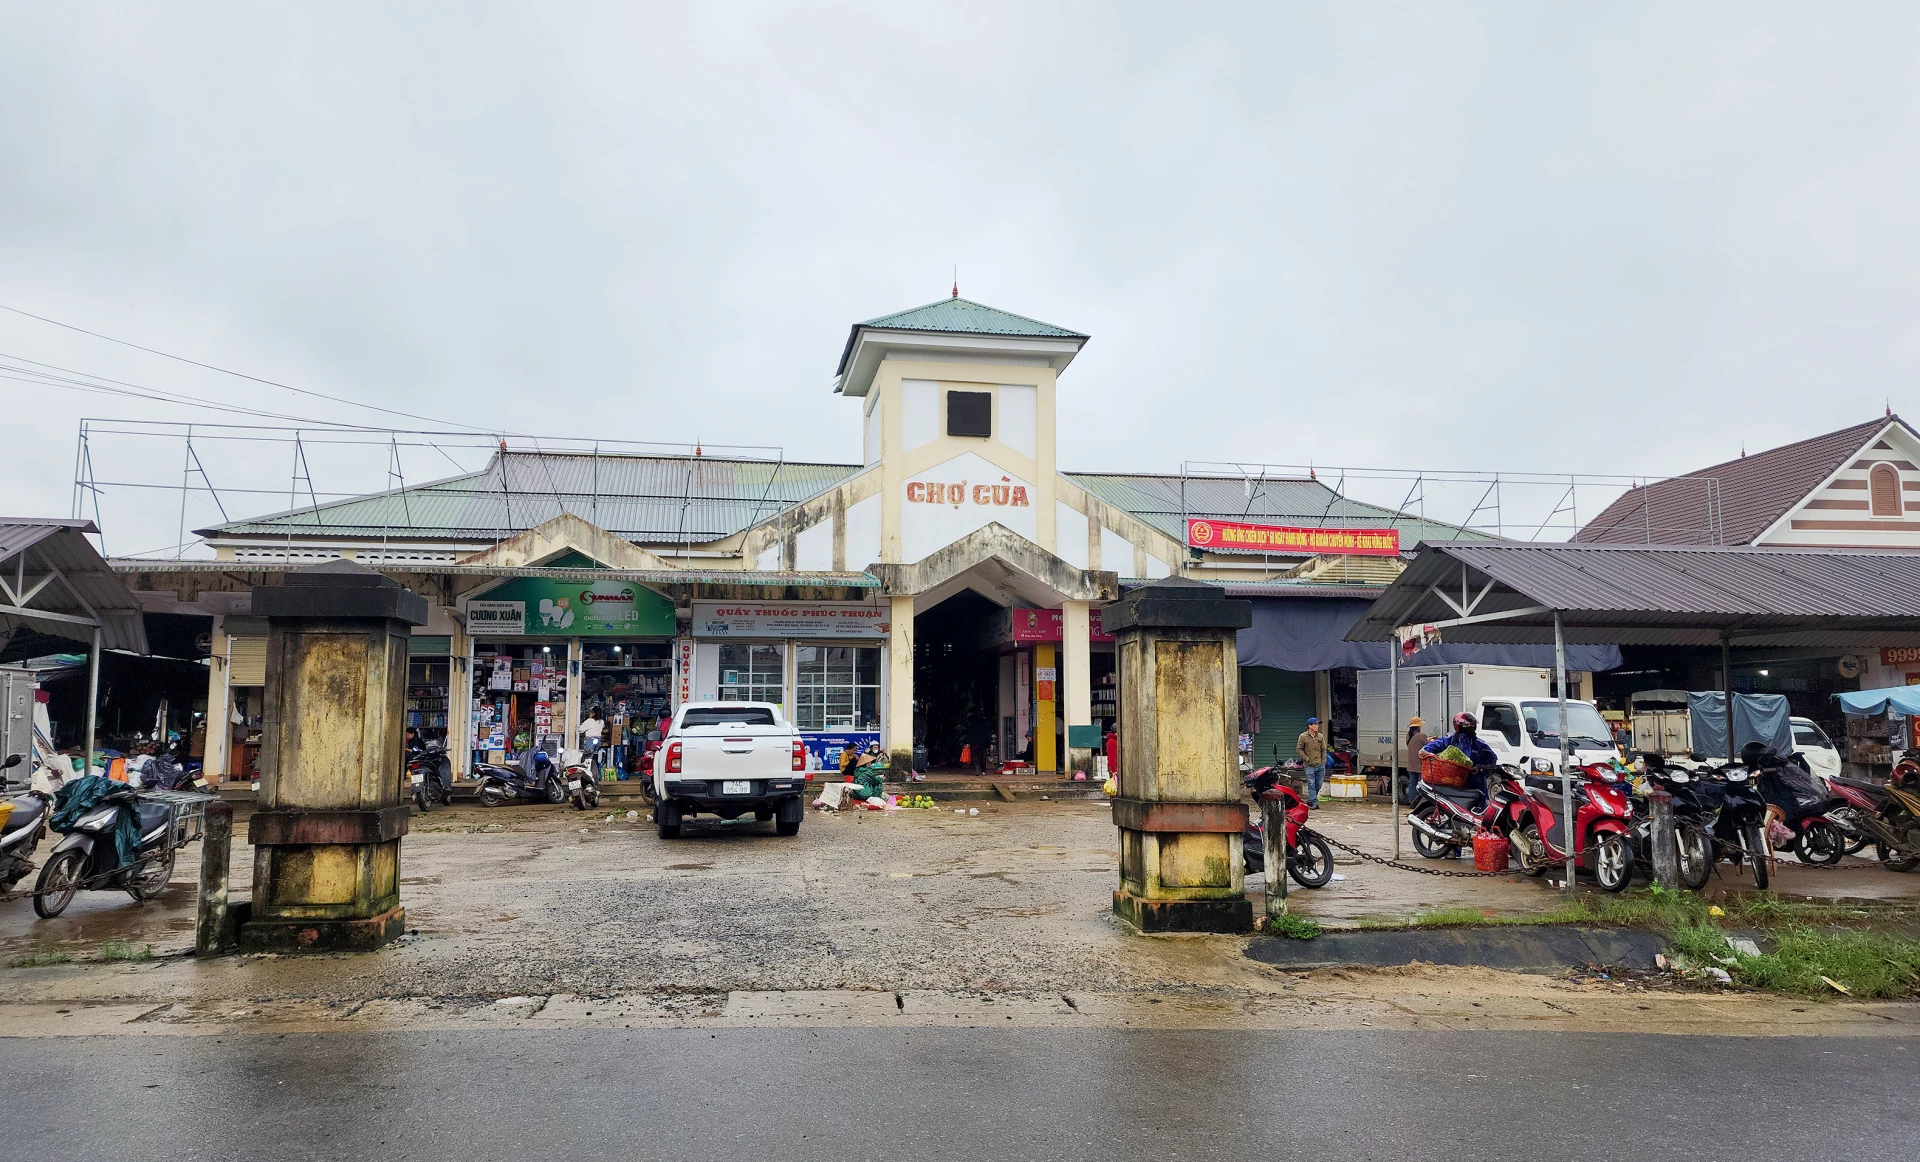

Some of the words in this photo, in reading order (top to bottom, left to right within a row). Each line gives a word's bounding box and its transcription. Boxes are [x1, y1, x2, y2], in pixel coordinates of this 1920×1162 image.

[907, 479, 967, 510] CHỢ
[499, 608, 522, 621] XUÂN
[618, 610, 639, 621] LED
[754, 607, 799, 617] THUỐC
[801, 608, 837, 617] PHÚC
[840, 609, 883, 619] THUẬN
